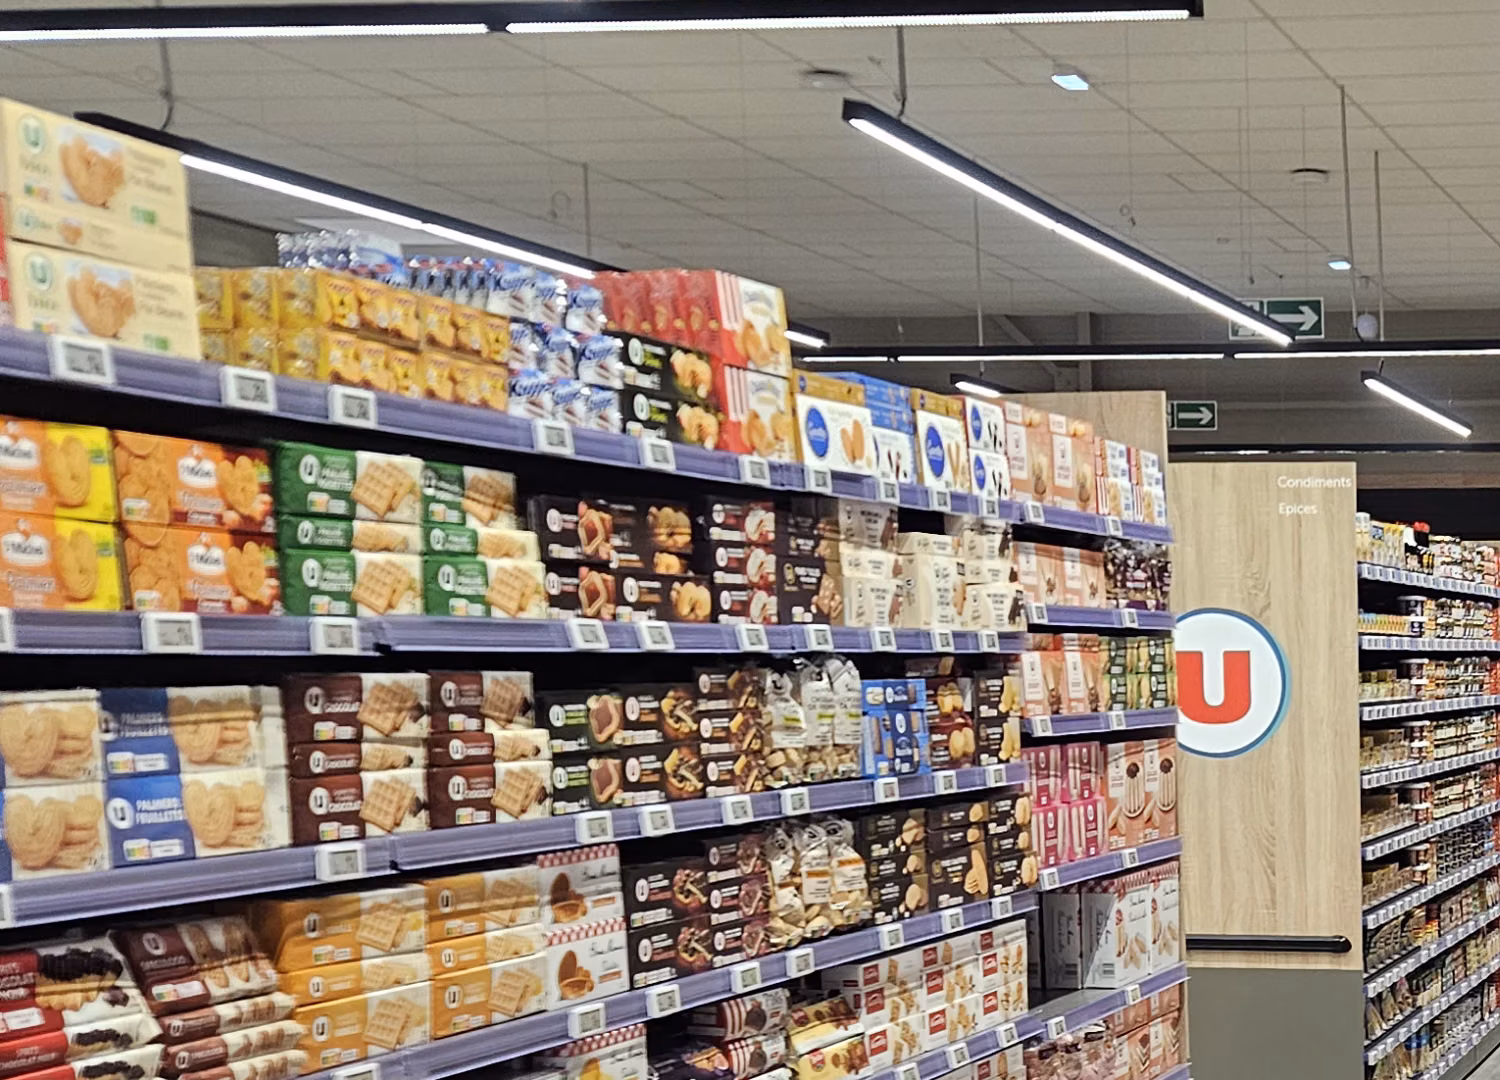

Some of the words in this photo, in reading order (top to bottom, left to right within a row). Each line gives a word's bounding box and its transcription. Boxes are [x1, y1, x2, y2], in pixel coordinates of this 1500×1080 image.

[1277, 475, 1352, 488] Condiments
[1278, 502, 1318, 517] Epices
[1176, 650, 1251, 725] U
[0, 962, 18, 974] RITS
[0, 974, 36, 989] OCOLAT
